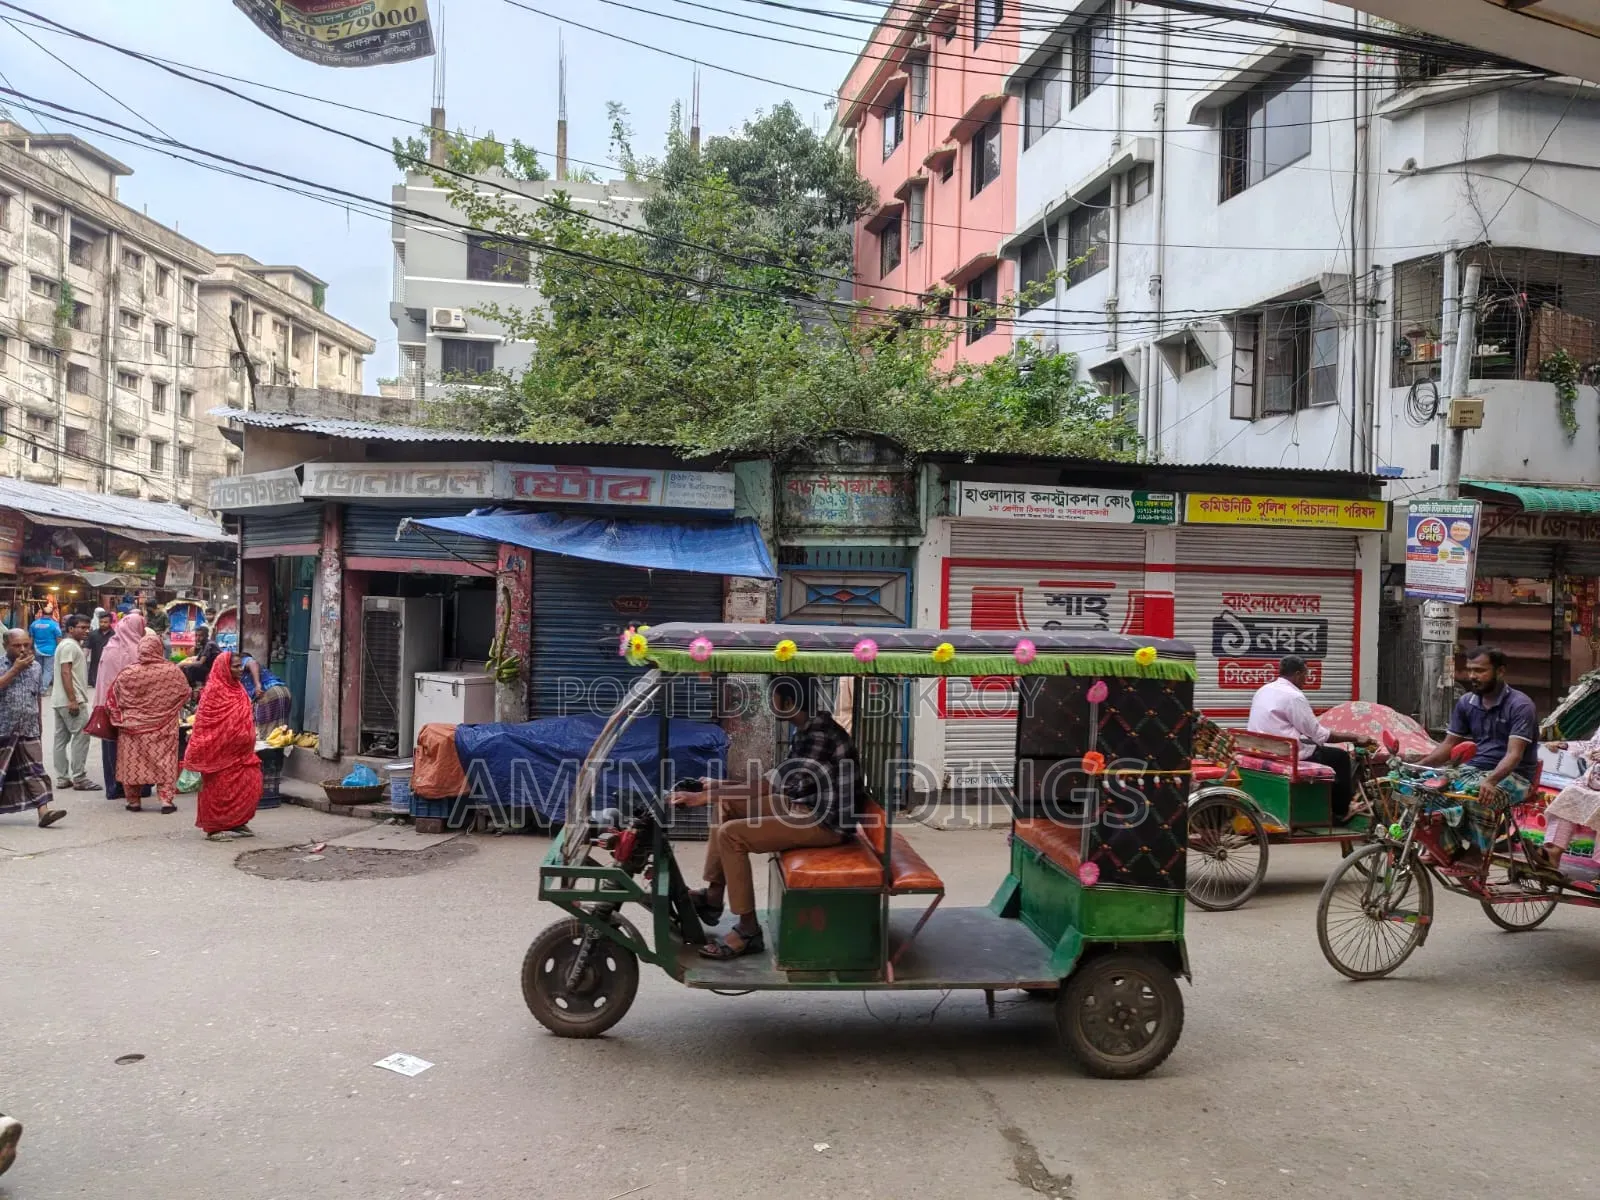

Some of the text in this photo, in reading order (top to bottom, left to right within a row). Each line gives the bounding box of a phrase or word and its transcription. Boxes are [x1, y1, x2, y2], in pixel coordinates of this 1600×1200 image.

[327, 6, 418, 40] 579000
[964, 488, 1025, 505] হাওলাদার
[1030, 489, 1098, 509] কনস্ট্রাকশন
[1104, 494, 1131, 509] কোং
[1199, 497, 1376, 519] কমিউনিটি পুলিশ পরিচালনা পরিষদ
[1222, 592, 1322, 613] বাংলাদেশের
